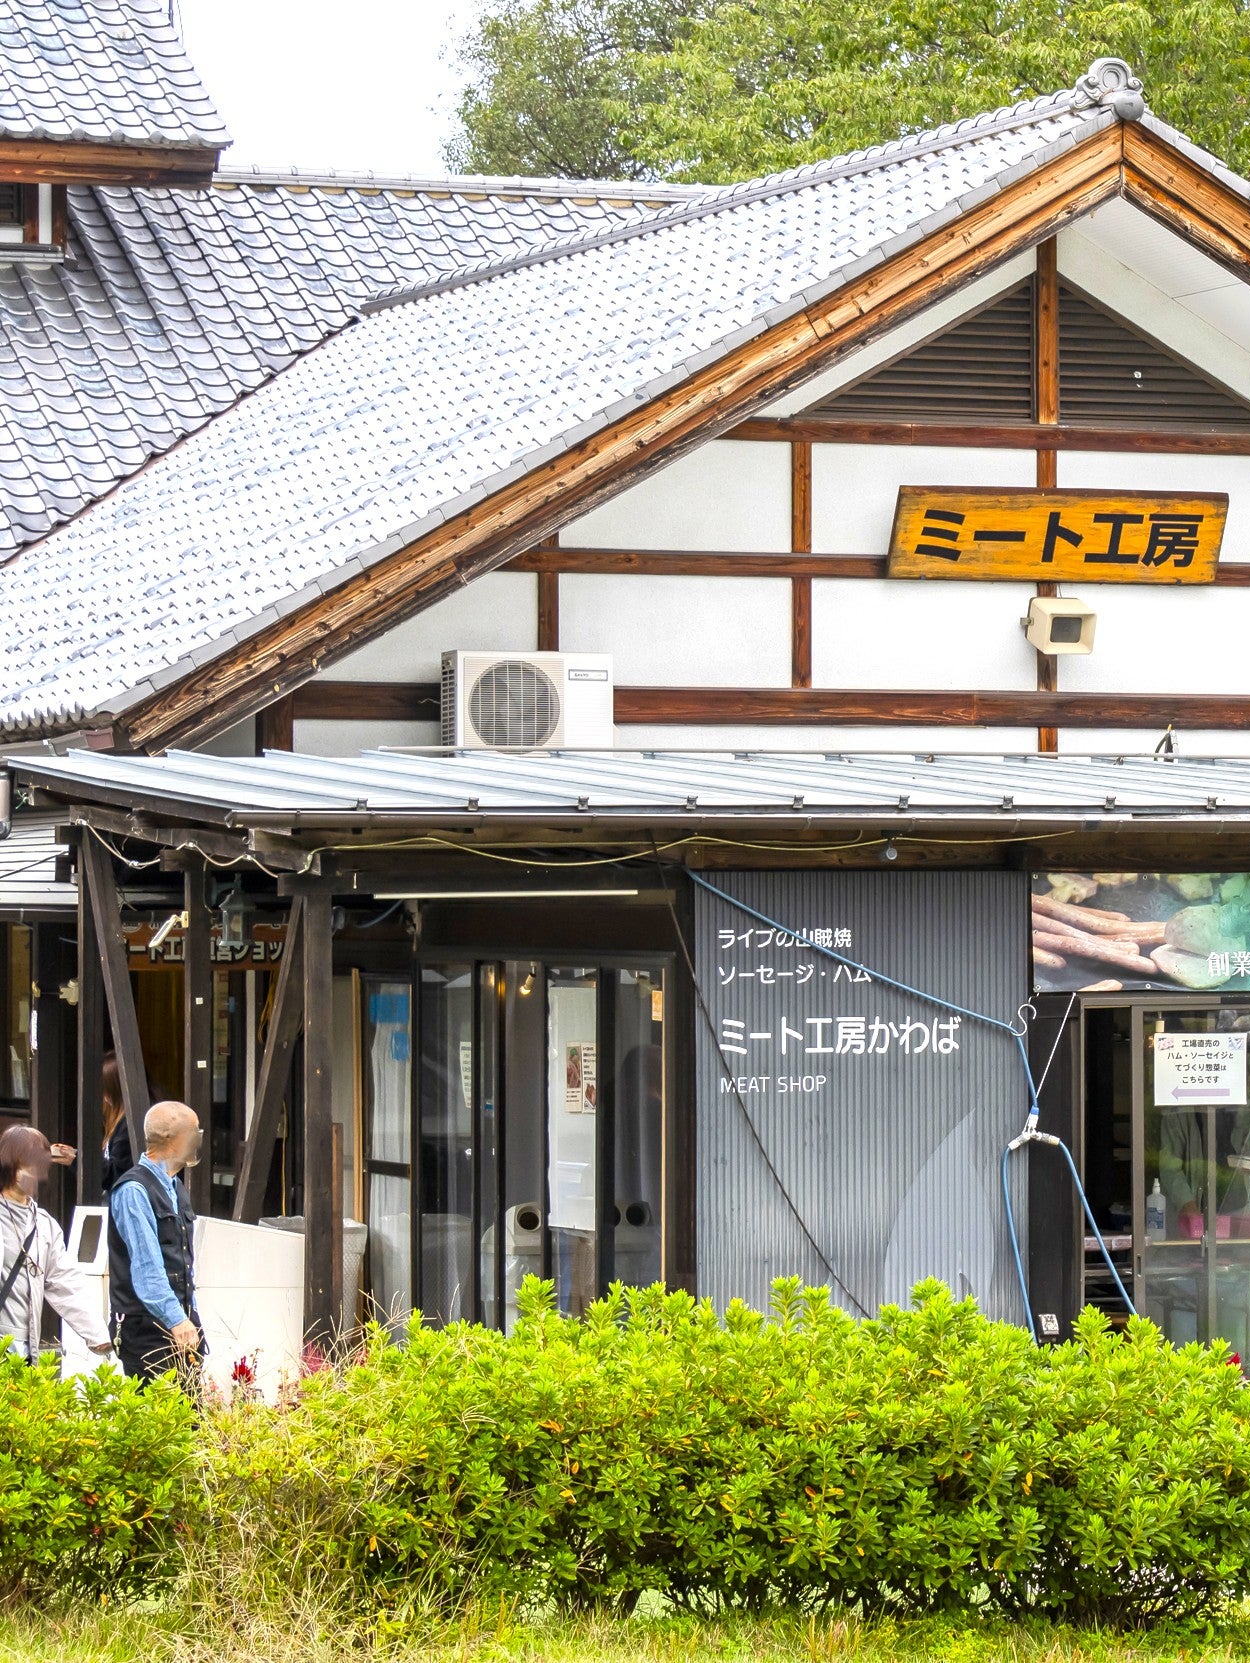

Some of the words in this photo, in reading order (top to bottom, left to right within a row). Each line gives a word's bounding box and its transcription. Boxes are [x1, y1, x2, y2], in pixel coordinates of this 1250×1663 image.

[914, 509, 1204, 568] ミート工房
[718, 928, 852, 948] ライブの山賊焼
[718, 964, 872, 985] ソーセージ・ハム
[720, 1015, 962, 1055] ミート工房かわば
[1182, 1039, 1220, 1048] 工場直売の
[1167, 1052, 1234, 1060] ハム・ソーセイジと
[1175, 1063, 1227, 1072] てづくり惣菜は
[721, 1077, 770, 1094] MEAT
[777, 1075, 827, 1092] SHOP
[1182, 1076, 1220, 1084] こちらです
